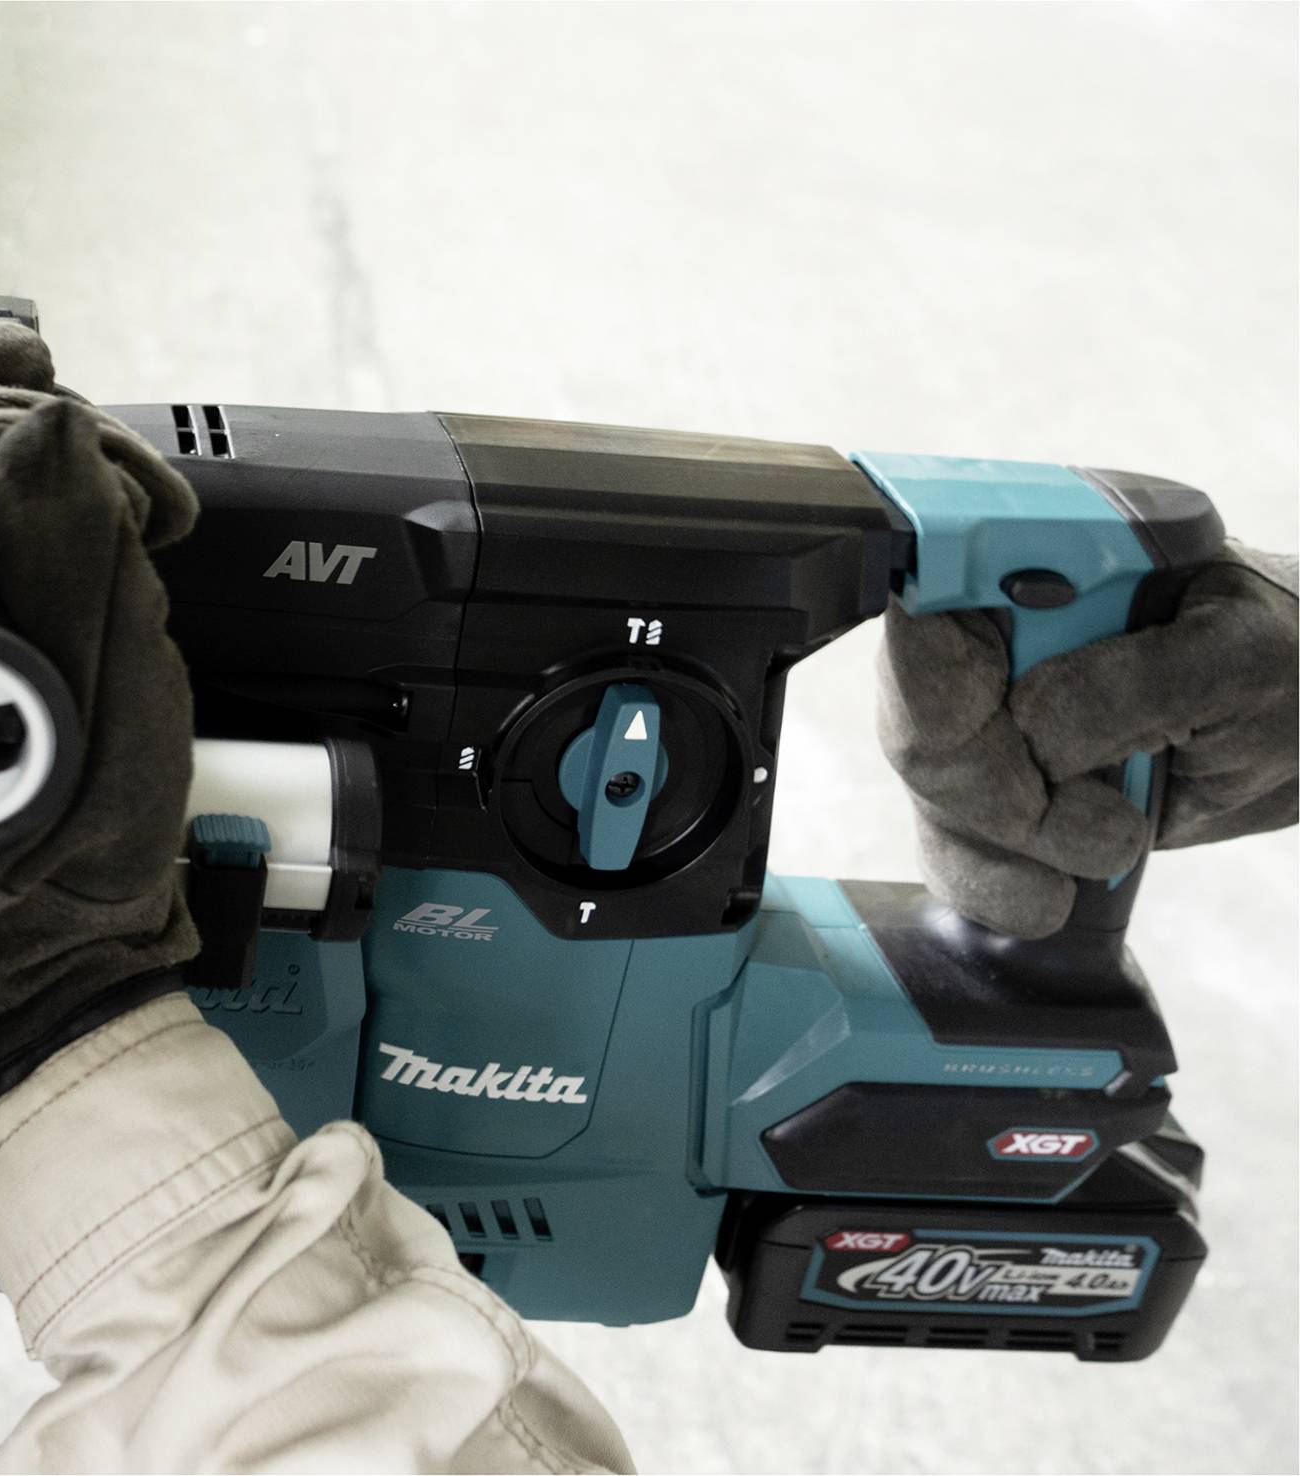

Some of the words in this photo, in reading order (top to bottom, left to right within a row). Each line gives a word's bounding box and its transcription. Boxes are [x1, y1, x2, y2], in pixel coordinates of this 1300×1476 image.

[262, 540, 378, 585] AVT
[401, 902, 499, 930] BL
[392, 921, 493, 942] MOTOR
[1001, 1132, 1088, 1155] XGT
[832, 1231, 904, 1250] XGT
[978, 1283, 1045, 1303] max
